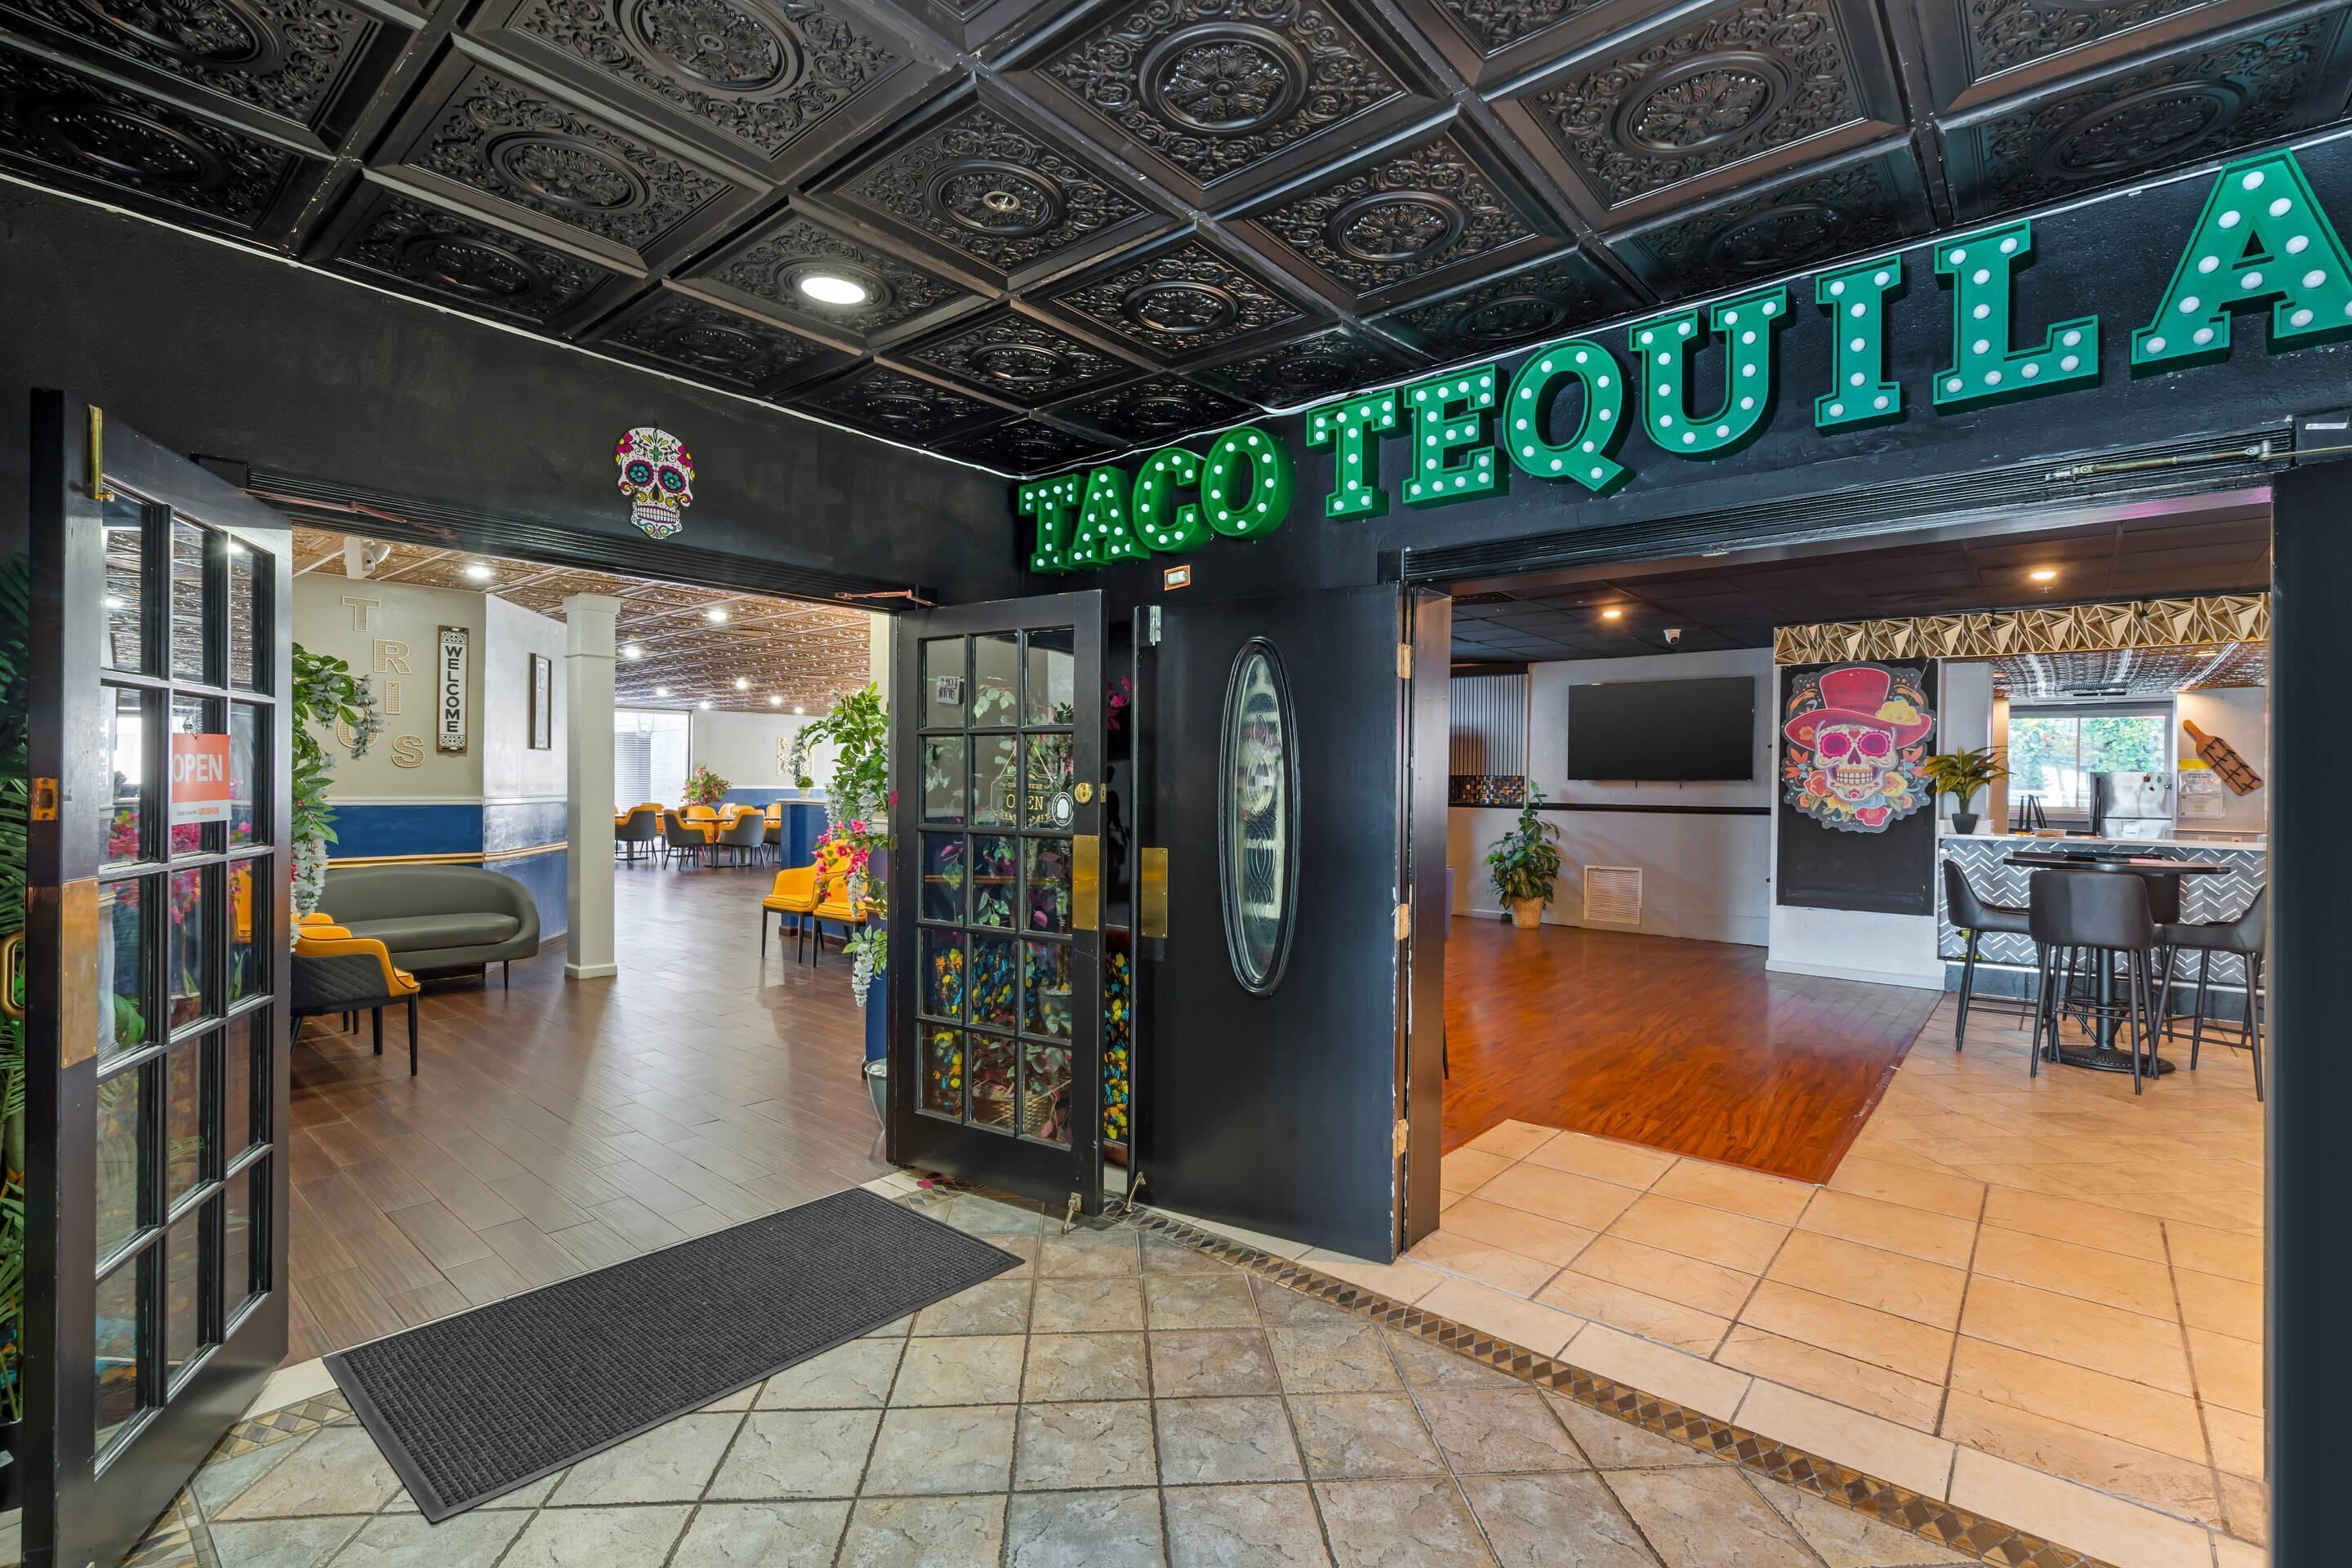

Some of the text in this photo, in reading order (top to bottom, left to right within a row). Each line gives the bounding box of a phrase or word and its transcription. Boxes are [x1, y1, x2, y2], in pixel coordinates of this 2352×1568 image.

[1018, 147, 2352, 572] TACO TEQUILA
[445, 645, 463, 733] WELCOME
[172, 753, 223, 784] OPEN
[1006, 794, 1044, 810] OEN
